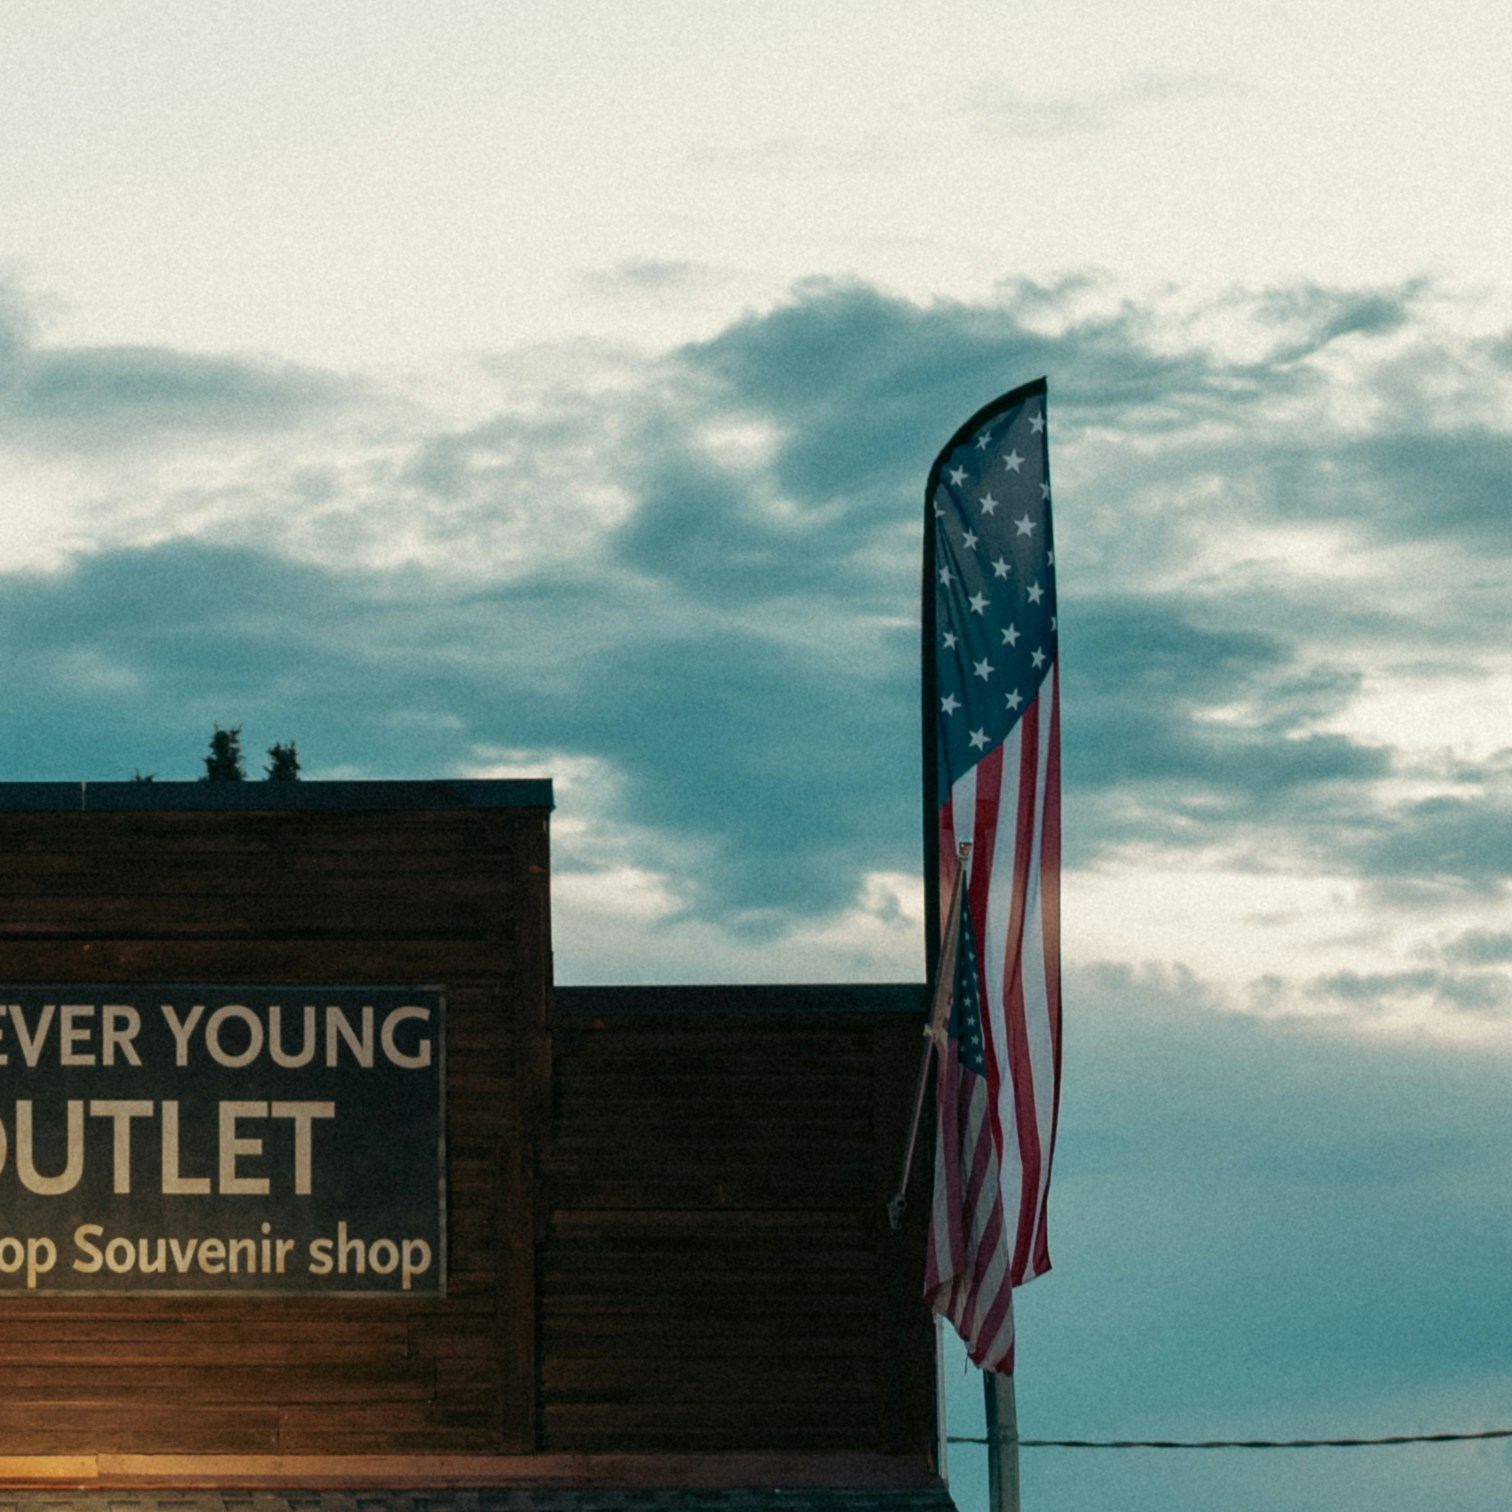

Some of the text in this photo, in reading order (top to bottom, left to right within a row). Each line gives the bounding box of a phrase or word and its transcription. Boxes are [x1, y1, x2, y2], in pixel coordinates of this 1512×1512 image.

[162, 1004, 433, 1069] YOUNG
[73, 1221, 295, 1274] Souvenir
[308, 1221, 433, 1291] shop
